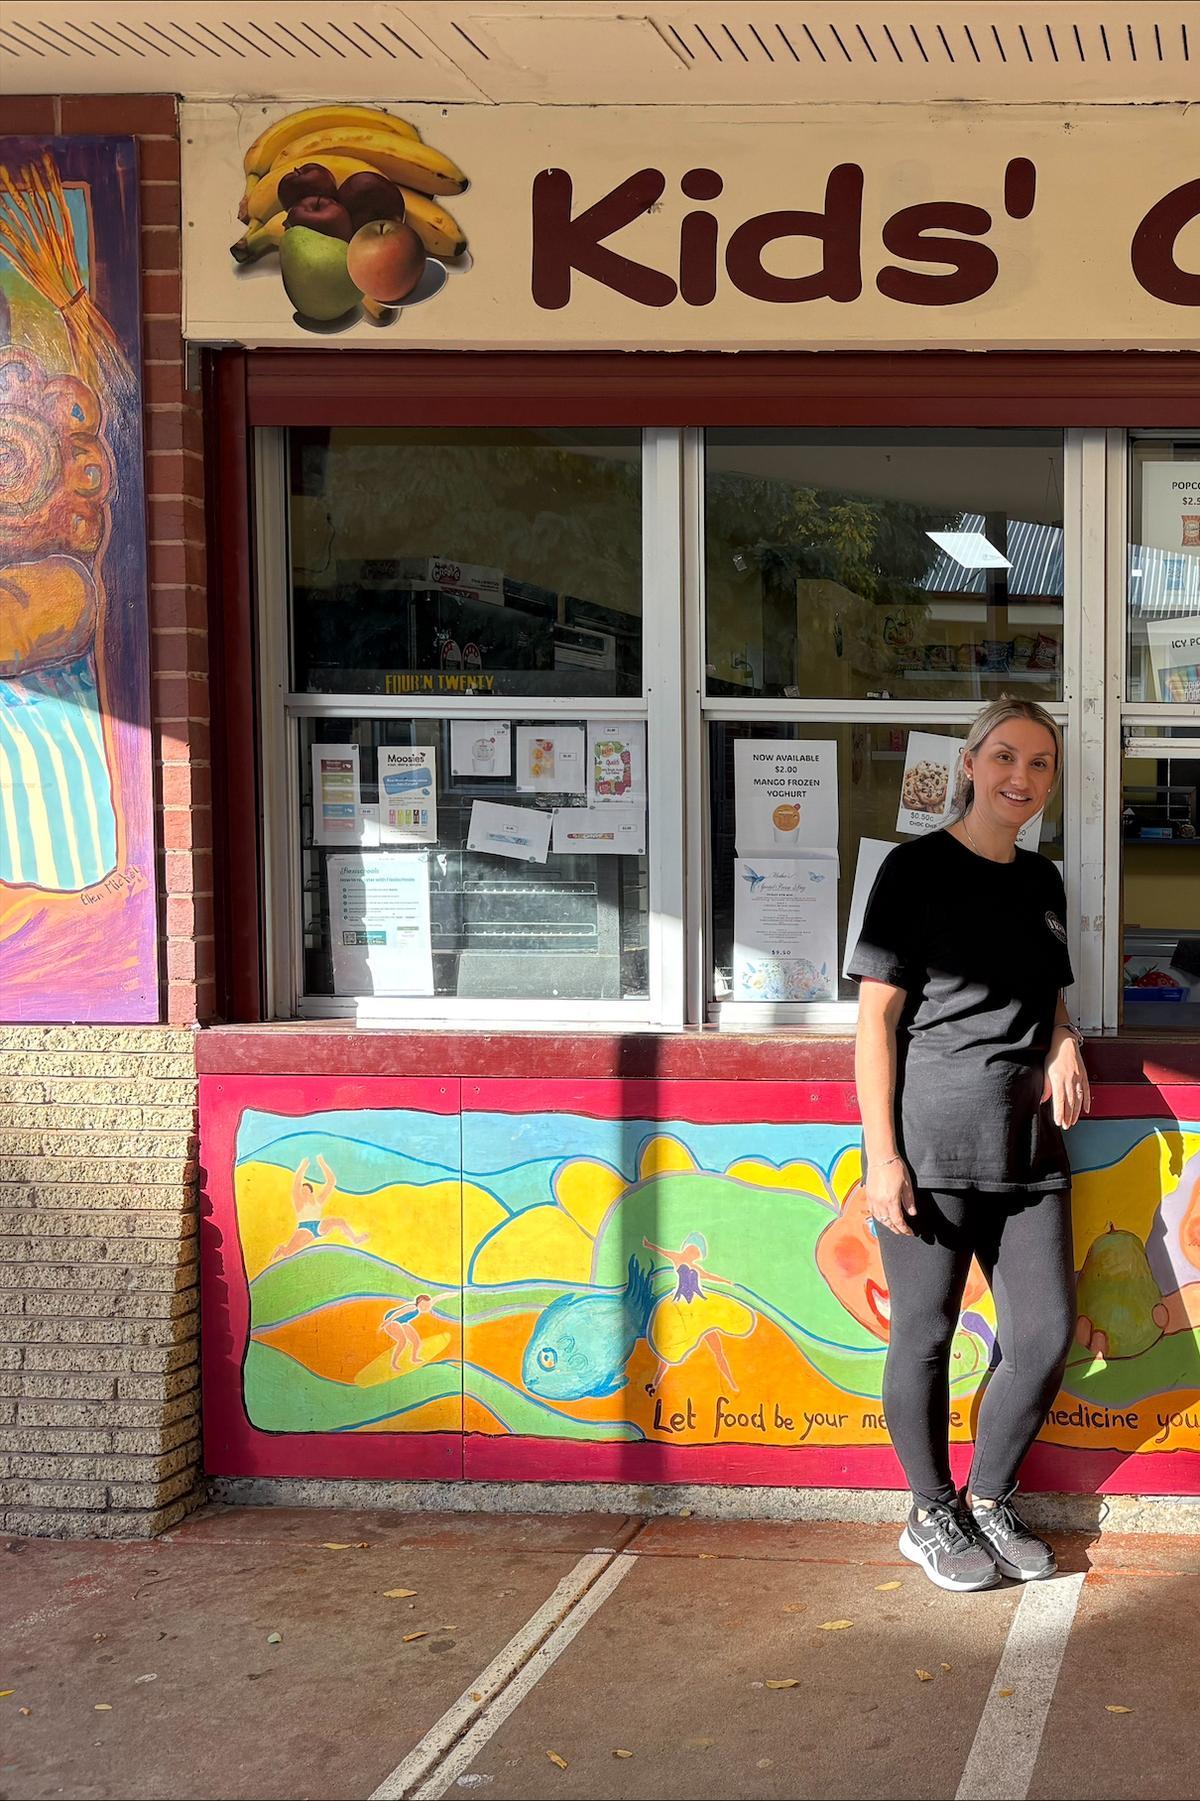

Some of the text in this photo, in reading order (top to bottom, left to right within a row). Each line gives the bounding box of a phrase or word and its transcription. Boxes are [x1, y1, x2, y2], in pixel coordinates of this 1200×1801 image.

[532, 157, 1036, 310] Kids'
[1172, 639, 1187, 649] ICY
[438, 672, 495, 690] TWENTY
[387, 753, 425, 763] Moosies
[776, 754, 820, 762] AVAILABLE
[714, 1397, 767, 1438] food
[774, 1403, 795, 1431] be
[799, 1411, 849, 1441] your
